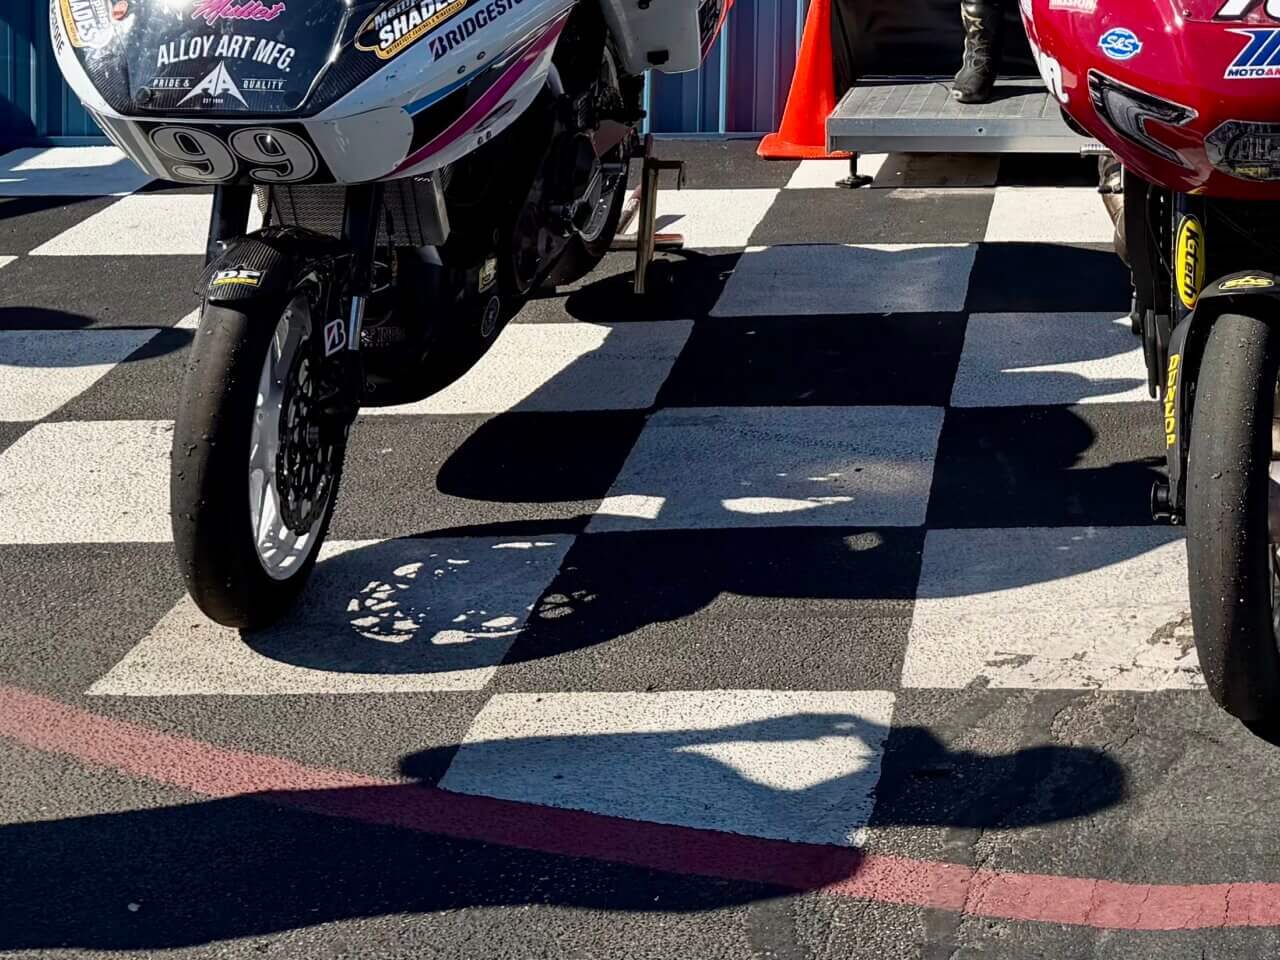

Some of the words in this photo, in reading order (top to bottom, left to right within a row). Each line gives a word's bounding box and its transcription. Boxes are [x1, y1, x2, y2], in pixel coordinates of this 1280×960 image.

[157, 34, 216, 68] ALLOY
[215, 34, 255, 58] ART
[252, 38, 296, 72] MFG.
[1106, 34, 1134, 51] S&S
[152, 79, 180, 88] PRIDE
[182, 80, 190, 88] &
[242, 79, 284, 90] QUALITY
[148, 124, 319, 184] 99
[1165, 353, 1182, 449] DUNLOP
